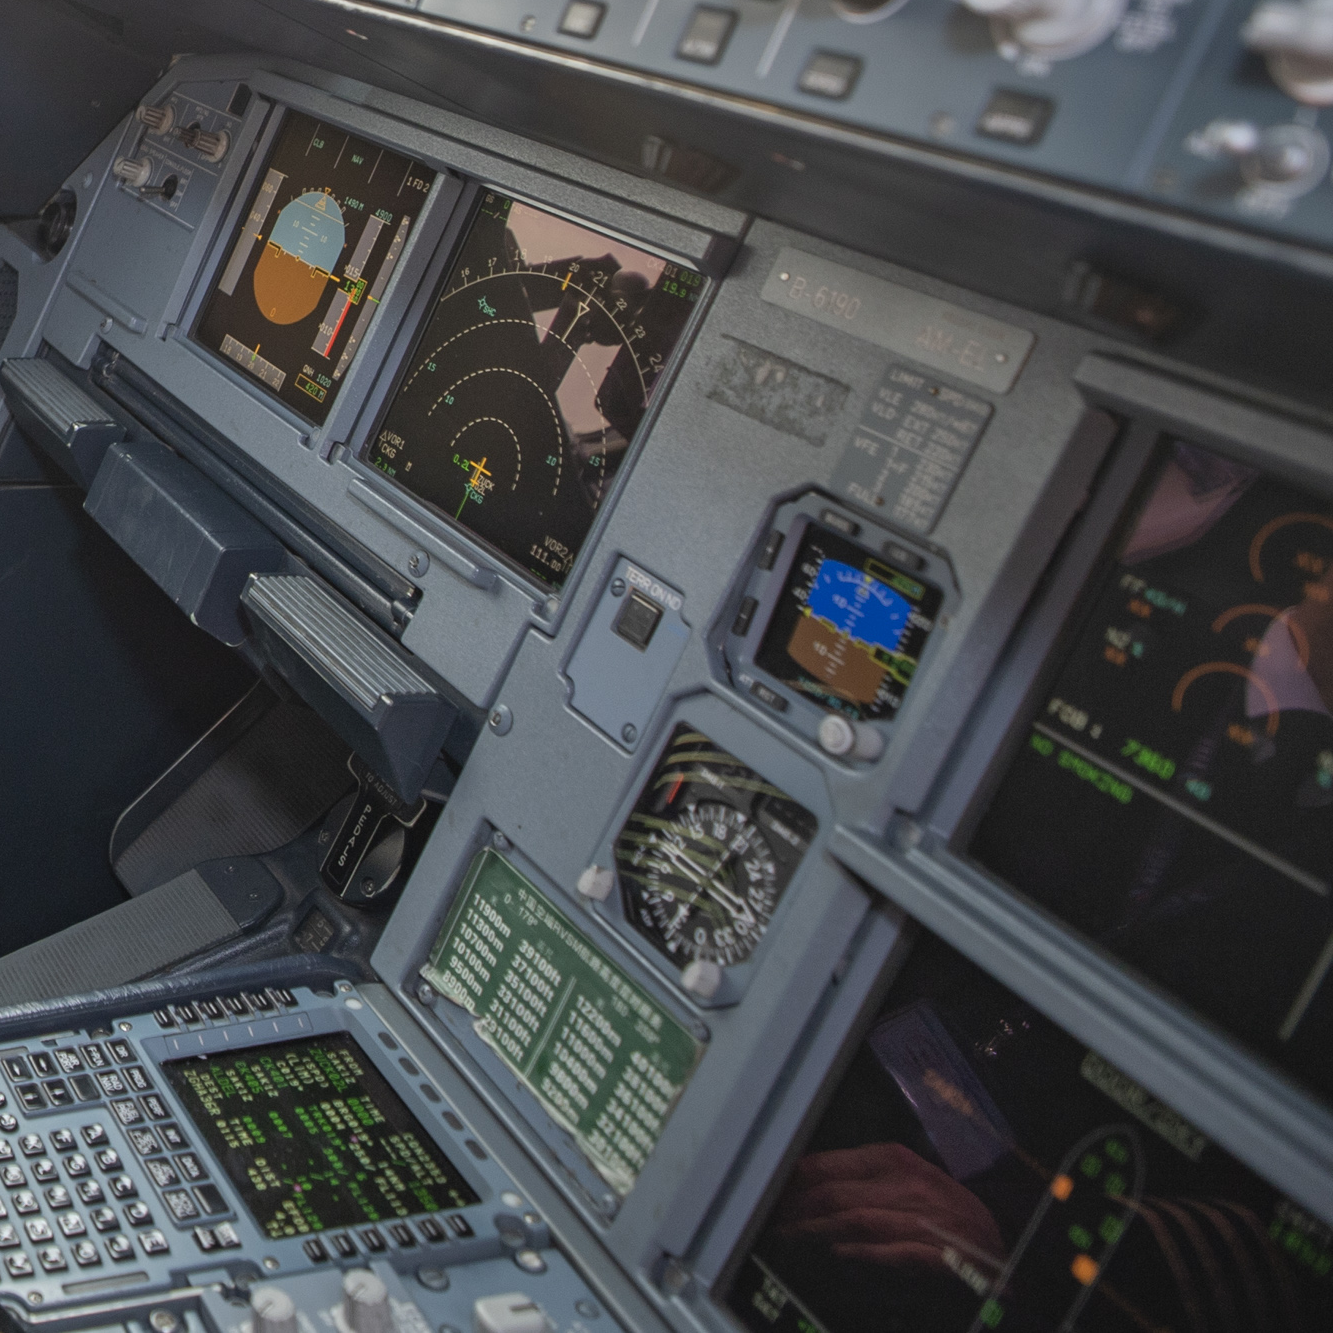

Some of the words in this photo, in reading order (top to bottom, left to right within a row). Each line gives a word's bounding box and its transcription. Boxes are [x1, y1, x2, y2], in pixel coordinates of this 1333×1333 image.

[312, 137, 325, 149] CLB
[351, 153, 364, 165] NAV
[412, 178, 424, 191] FD
[375, 207, 394, 222] 4900
[292, 219, 300, 229] 10
[320, 233, 328, 244] 10
[662, 280, 687, 298] 19.9
[788, 275, 862, 320] B-6190
[460, 267, 471, 278] 16
[487, 257, 497, 268] 17
[513, 248, 528, 262] 18
[568, 261, 581, 273] 20
[591, 271, 608, 288] 21
[615, 297, 629, 311] 22
[634, 324, 647, 340] 23
[648, 353, 663, 373] 24
[482, 304, 497, 317] SHC
[223, 344, 232, 355] 18
[259, 368, 267, 379] 21
[271, 377, 280, 388] 22
[302, 364, 315, 378] QNH
[316, 373, 332, 388] 1020
[427, 361, 437, 372] 15
[304, 381, 319, 395] 420
[444, 394, 455, 406] 10
[381, 443, 397, 459] CKG
[386, 432, 406, 451] VOR1
[452, 453, 471, 472] 0.2L
[545, 454, 558, 467] 10
[589, 455, 601, 467] 15
[477, 474, 495, 492] ZUCK
[469, 491, 484, 505] CKG
[530, 544, 562, 572] 111.00
[544, 535, 569, 559] VOR2
[624, 566, 652, 592] TERR
[649, 582, 666, 600] ON
[665, 592, 683, 611] ND
[337, 803, 373, 868] PEDALS
[469, 892, 513, 938] 11900m
[463, 906, 507, 953] 11300m
[456, 920, 500, 968] 10700m
[449, 935, 493, 983] 10100m
[516, 937, 563, 988] 39100ft
[446, 953, 485, 997] 9500m
[509, 952, 556, 1003] 37100ft
[440, 968, 478, 1012] 8900m
[501, 967, 549, 1019] 35100ft
[494, 982, 541, 1033] 33100ft
[572, 992, 624, 1048] 12200m
[480, 1011, 525, 1063] 29100ft
[487, 997, 533, 1049] 31100ft
[564, 1008, 617, 1064] 11600m
[85, 1046, 106, 1067] F-PLN
[335, 1048, 366, 1076] FROM
[557, 1024, 609, 1080] 11000m
[98, 1075, 115, 1092] NAV
[107, 1075, 123, 1090] RAD
[126, 1067, 148, 1089] PROG
[181, 1068, 221, 1116] ZGHA36R
[356, 1095, 387, 1123] TIME
[198, 1072, 224, 1100] DEST
[227, 1117, 254, 1146] TIME
[252, 1157, 282, 1188] DIST
[180, 1156, 202, 1178] DATA
